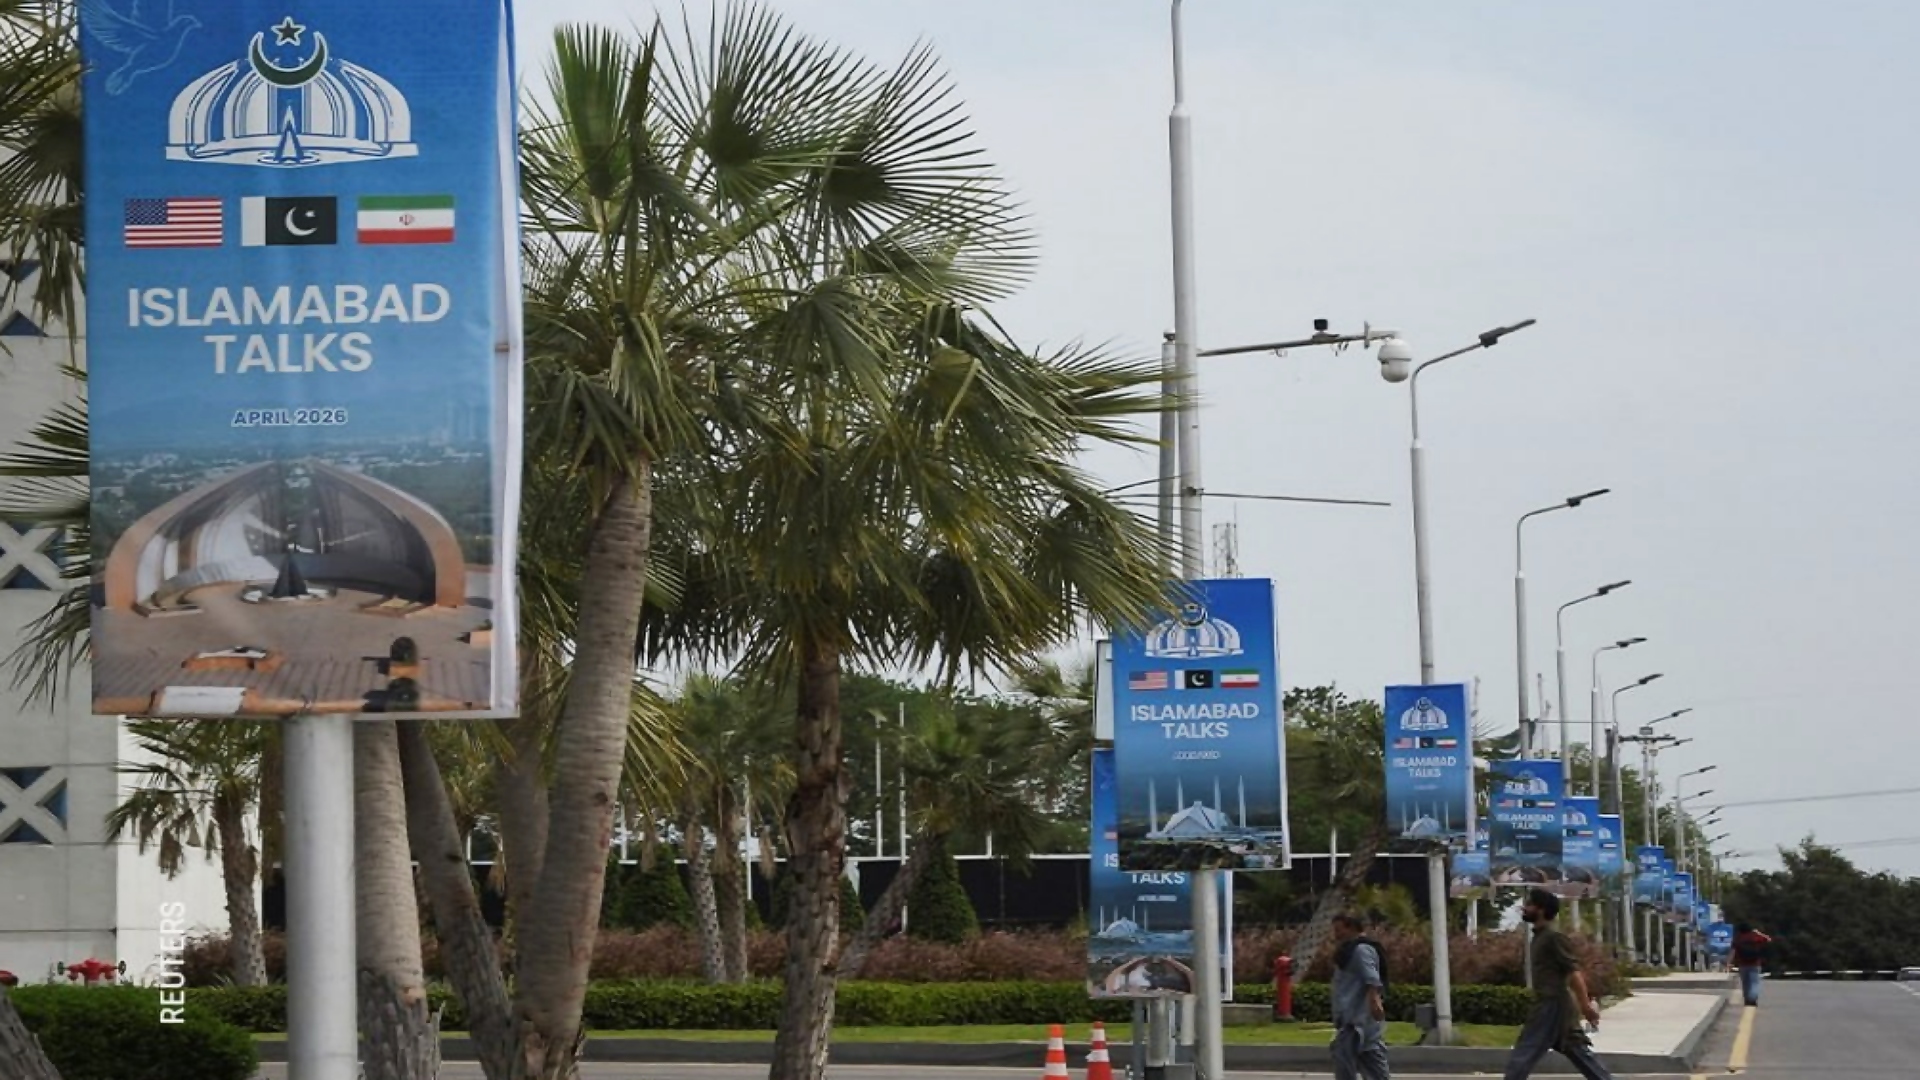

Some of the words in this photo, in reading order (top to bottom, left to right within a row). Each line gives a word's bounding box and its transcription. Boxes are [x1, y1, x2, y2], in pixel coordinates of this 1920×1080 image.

[128, 283, 451, 328] ISLAMABAD
[204, 332, 373, 375] TALKS
[232, 410, 291, 427] APRIL
[294, 407, 348, 426] 2026
[1130, 703, 1260, 722] ISLAMABAD
[1162, 722, 1229, 739] TALKS
[1131, 872, 1186, 885] TALKS
